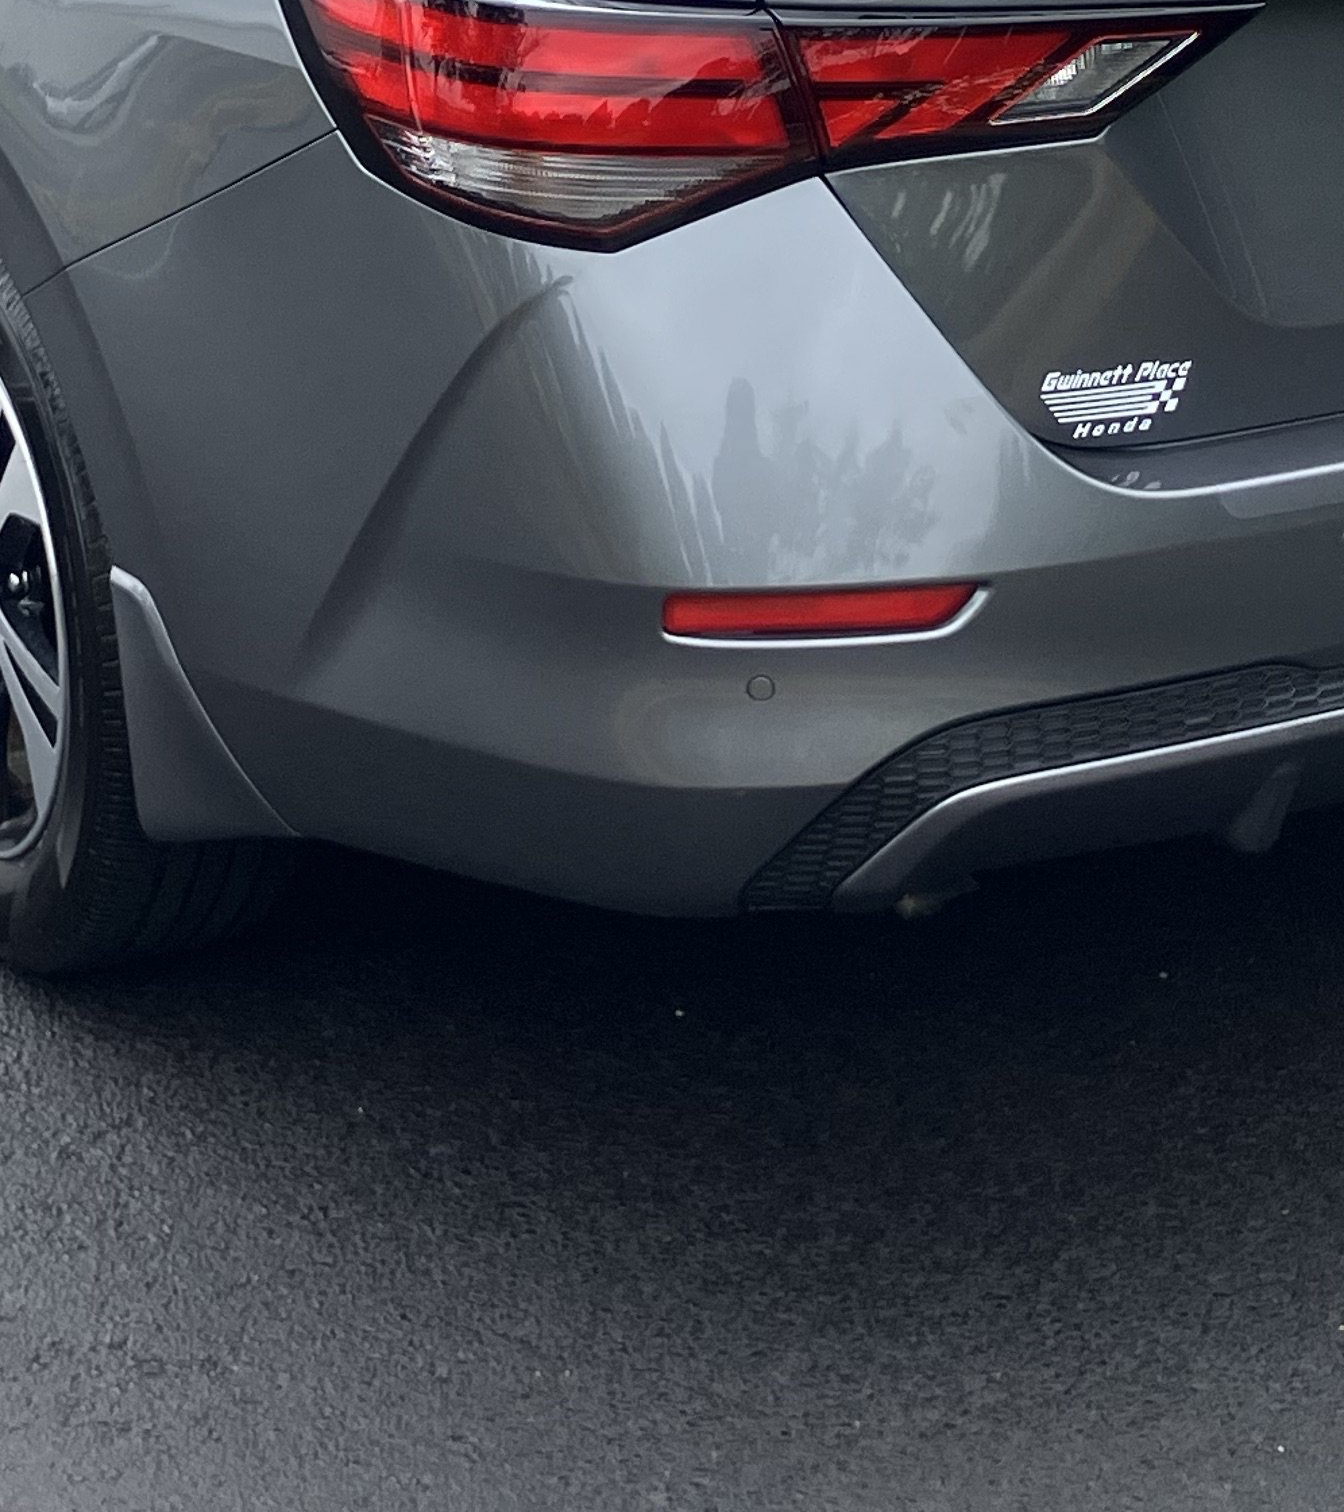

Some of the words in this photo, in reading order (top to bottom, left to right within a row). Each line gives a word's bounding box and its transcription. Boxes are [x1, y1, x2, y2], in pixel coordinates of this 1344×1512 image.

[1040, 363, 1134, 392] Gwinnett
[1134, 359, 1193, 382] Place
[1072, 416, 1153, 439] Honda
